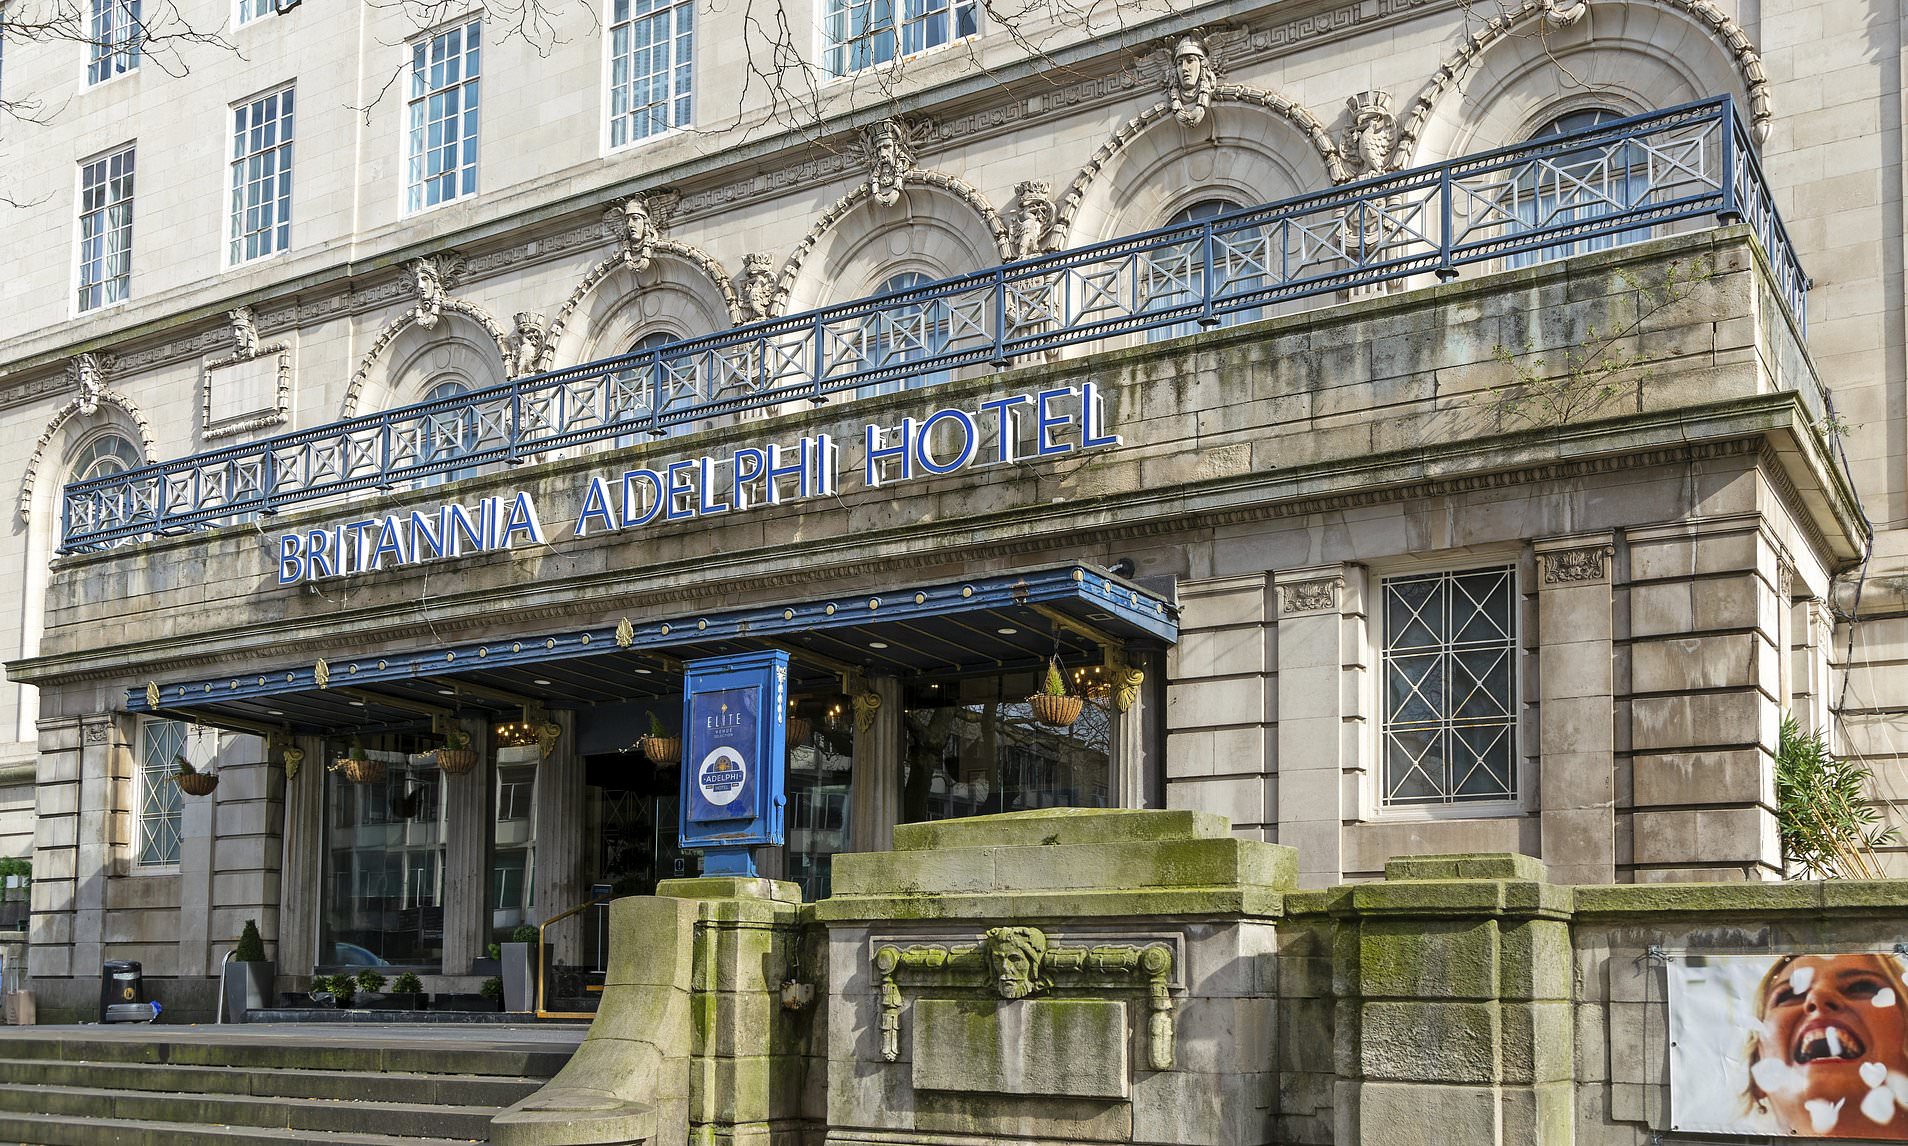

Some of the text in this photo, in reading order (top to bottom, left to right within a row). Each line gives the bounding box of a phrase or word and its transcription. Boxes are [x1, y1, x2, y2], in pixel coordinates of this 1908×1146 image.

[278, 381, 1123, 585] BRITANNIA ADELPHI HOTEL
[707, 712, 741, 728] ELITE
[705, 773, 739, 783] ADELPHI
